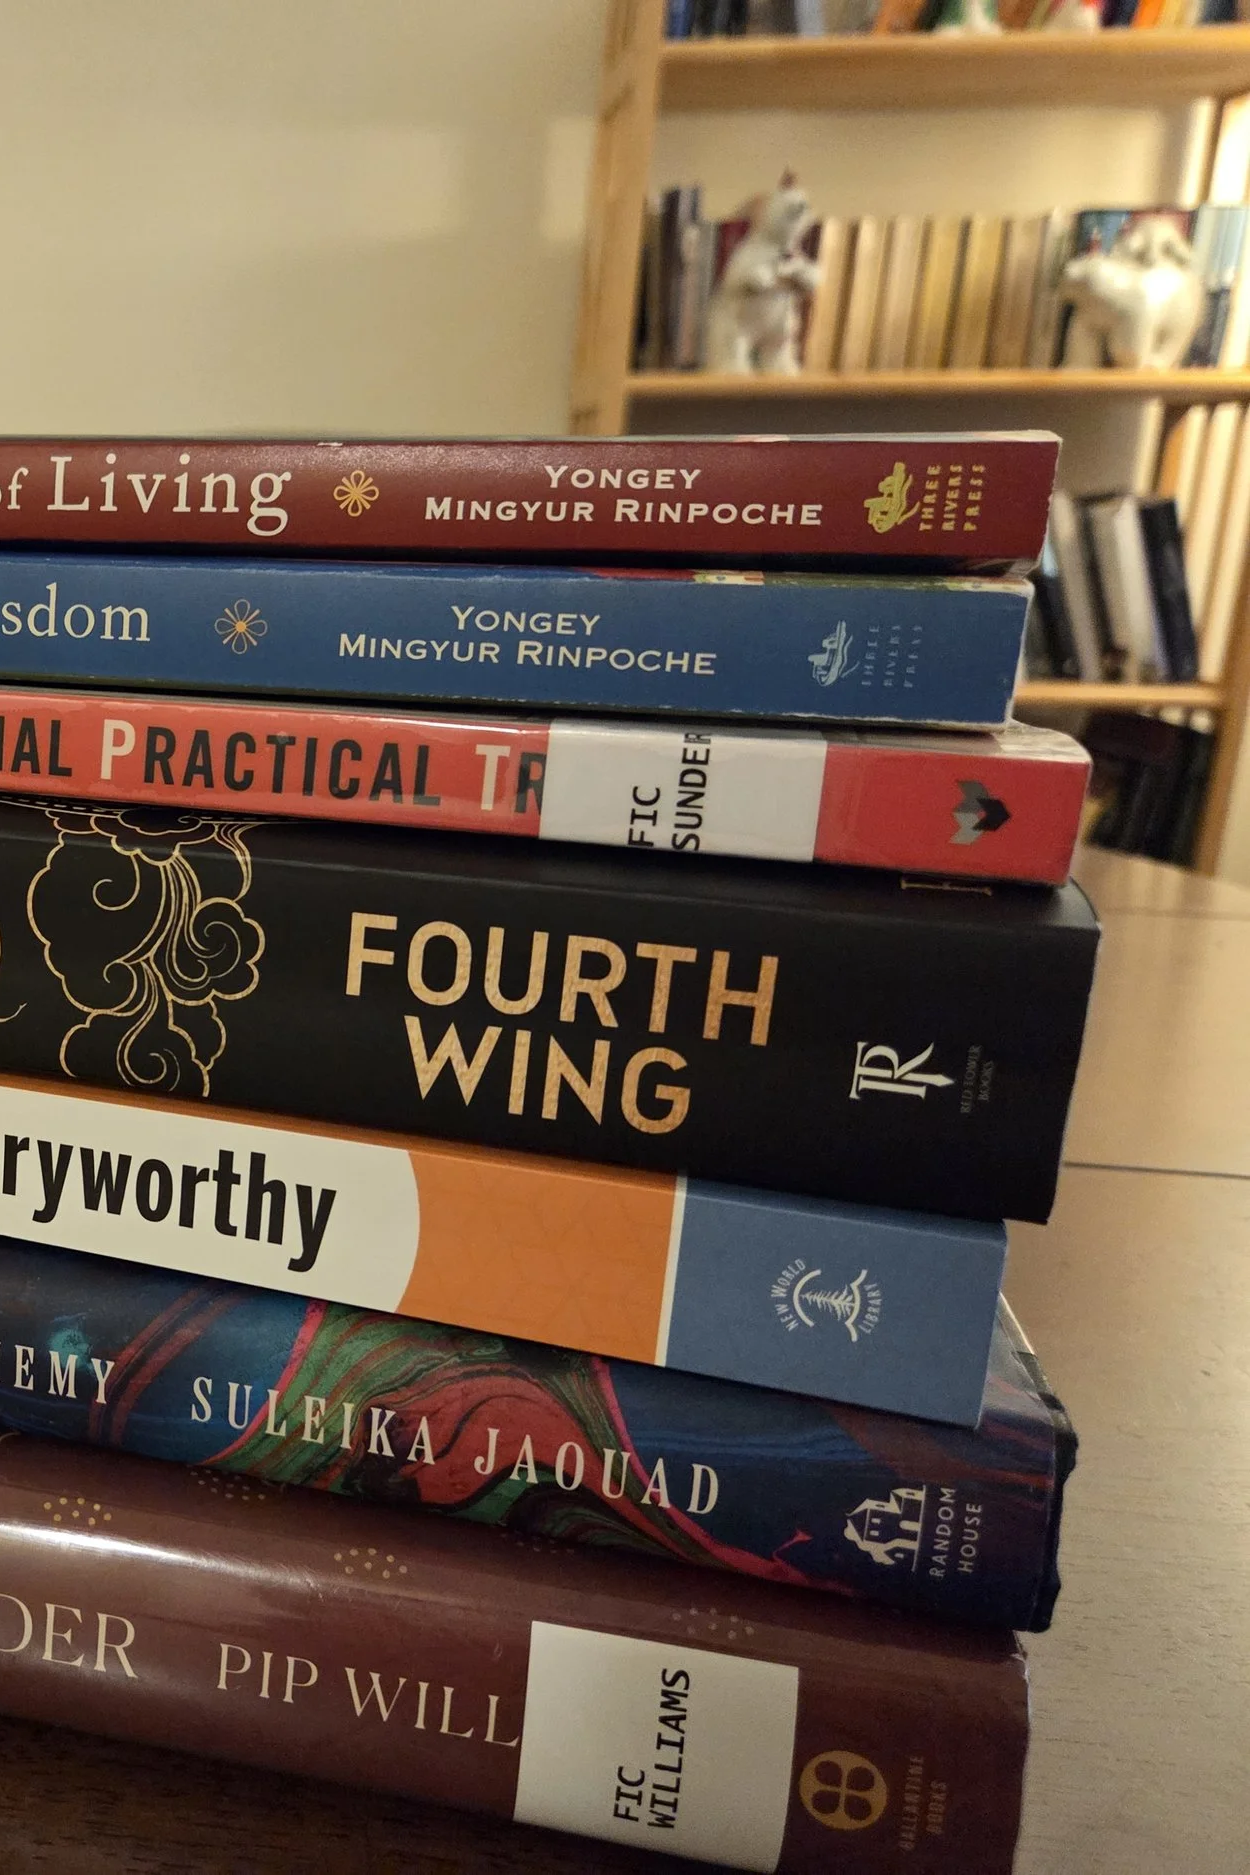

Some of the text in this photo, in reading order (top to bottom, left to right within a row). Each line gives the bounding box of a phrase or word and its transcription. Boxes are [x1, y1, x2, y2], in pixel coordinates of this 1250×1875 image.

[47, 452, 292, 536] Living
[424, 497, 823, 527] MINGYUR RINPOCHE
[544, 465, 701, 491] YONGEY
[918, 464, 941, 531] THREE
[942, 464, 963, 531] RIVERS
[963, 464, 986, 531] PRESS
[338, 633, 716, 675] MINGYUR RINPOCHE
[451, 606, 601, 636] YONGEY
[100, 719, 441, 807] PRACTICAL
[671, 732, 712, 851] SUNDER
[628, 786, 661, 848] FIC
[345, 911, 779, 1047] FOURTH
[404, 1014, 692, 1135] WING
[771, 1258, 806, 1332] NEW WORLD
[858, 1282, 882, 1334] LIBRARY
[191, 1376, 719, 1516] SULEIKA JAOUAD
[929, 1487, 956, 1577] RANDOM
[958, 1503, 983, 1573] HOUSE
[216, 1643, 519, 1748] PIP WILL
[648, 1668, 691, 1830] WILLIAMS
[613, 1765, 646, 1824] FIC
